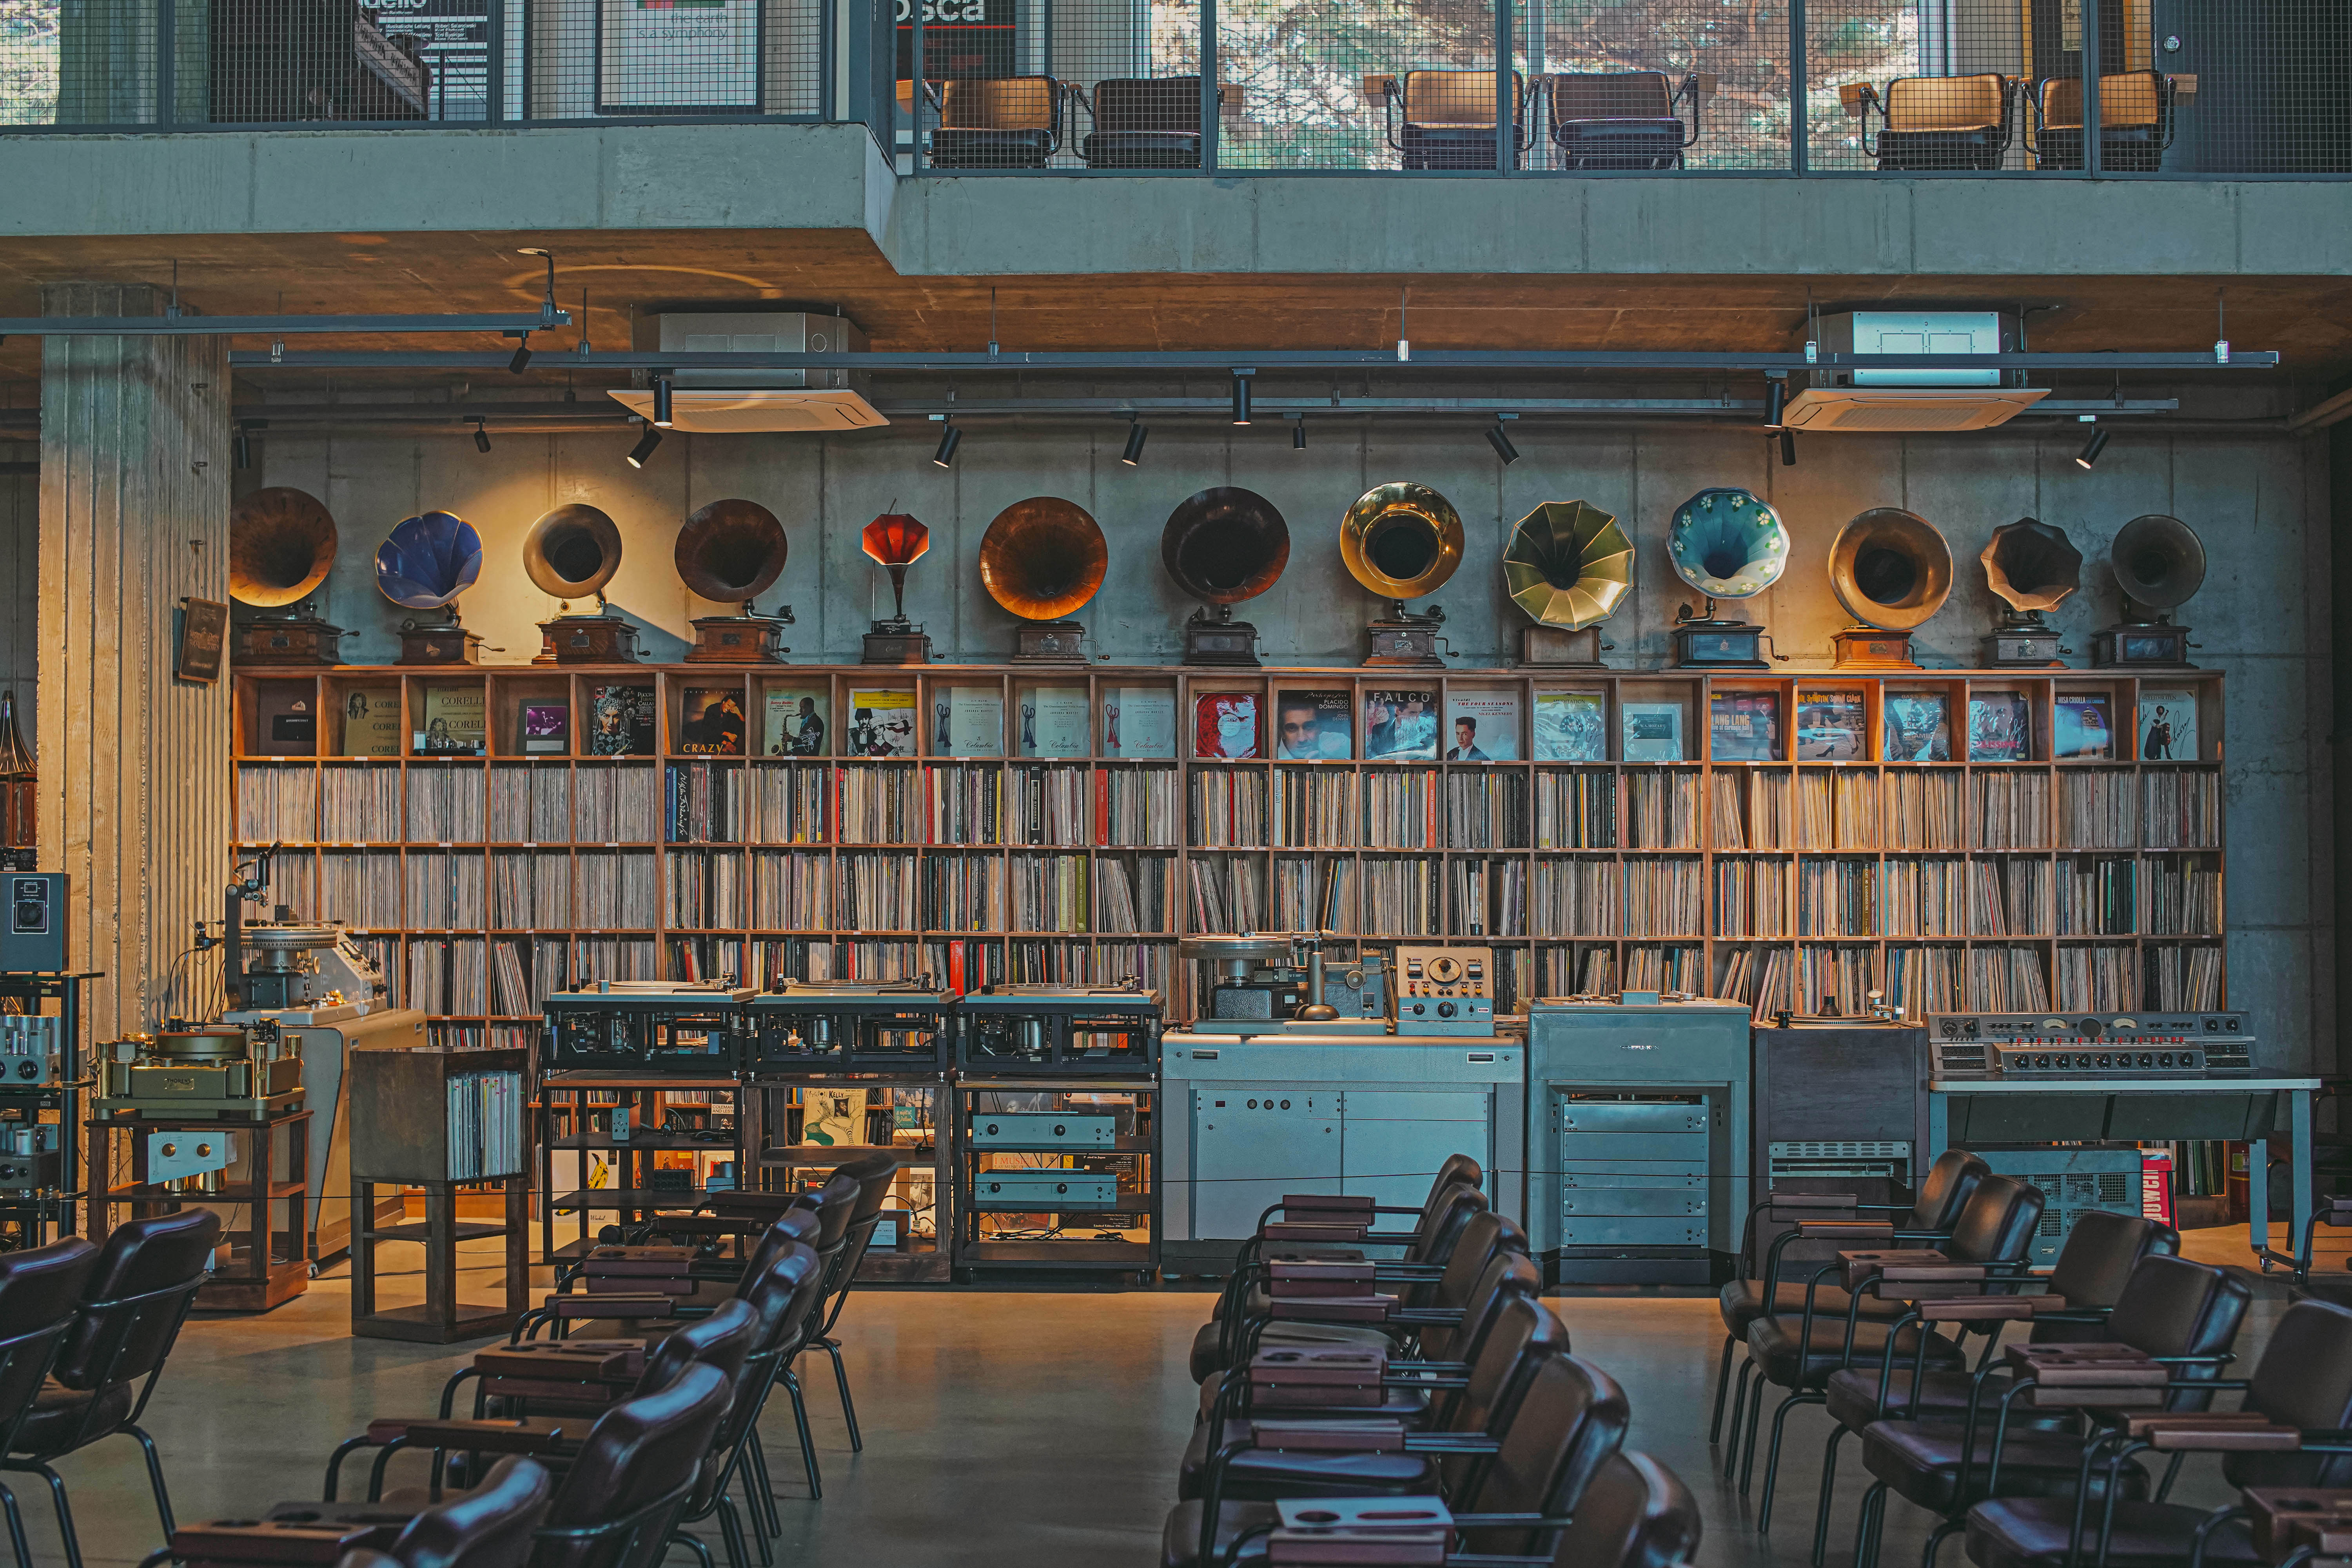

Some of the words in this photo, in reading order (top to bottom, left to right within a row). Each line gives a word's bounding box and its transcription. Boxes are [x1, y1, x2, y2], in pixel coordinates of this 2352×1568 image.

[670, 13, 691, 24] the
[695, 12, 727, 24] earth
[662, 27, 728, 41] symphony
[1374, 692, 1430, 702] FALCO
[1847, 693, 1861, 703] CLARK
[1711, 714, 1730, 726] LANG
[1731, 714, 1749, 726] LANG
[964, 740, 994, 749] Columbia
[1049, 740, 1079, 749] Columbia
[1134, 740, 1164, 749] Columbia
[829, 1090, 844, 1098] KELLY
